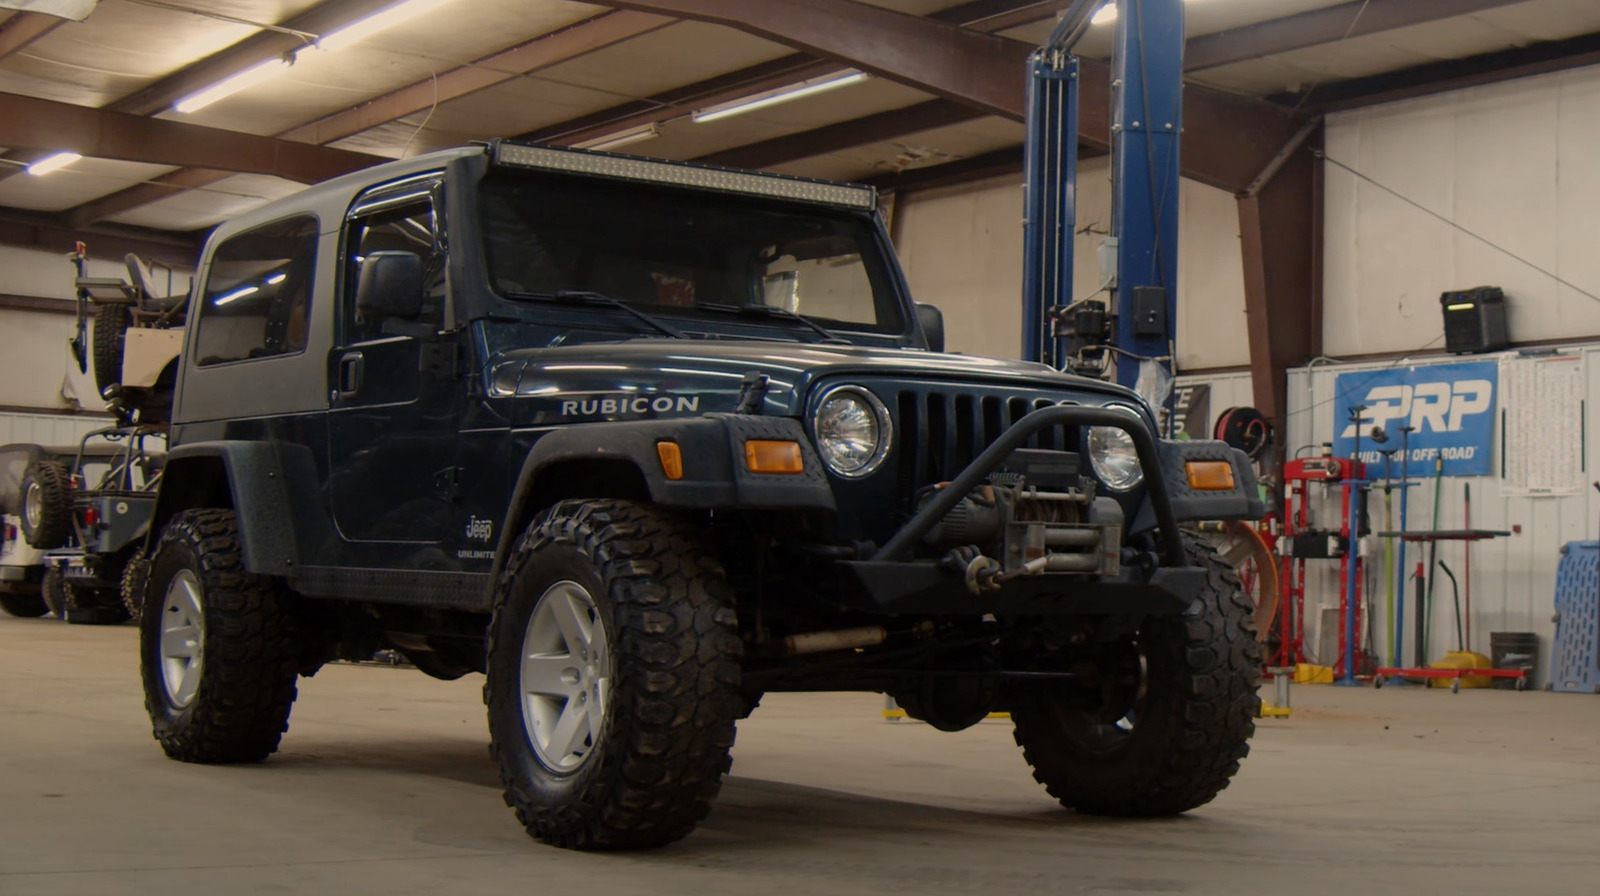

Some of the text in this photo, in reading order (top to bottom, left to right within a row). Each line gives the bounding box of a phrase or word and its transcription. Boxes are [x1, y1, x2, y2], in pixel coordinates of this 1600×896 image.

[562, 396, 699, 416] RUBICON
[1341, 379, 1492, 438] PRP
[1388, 449, 1410, 462] OR
[466, 514, 493, 543] Jeep
[457, 550, 497, 559] UNLIMITE
